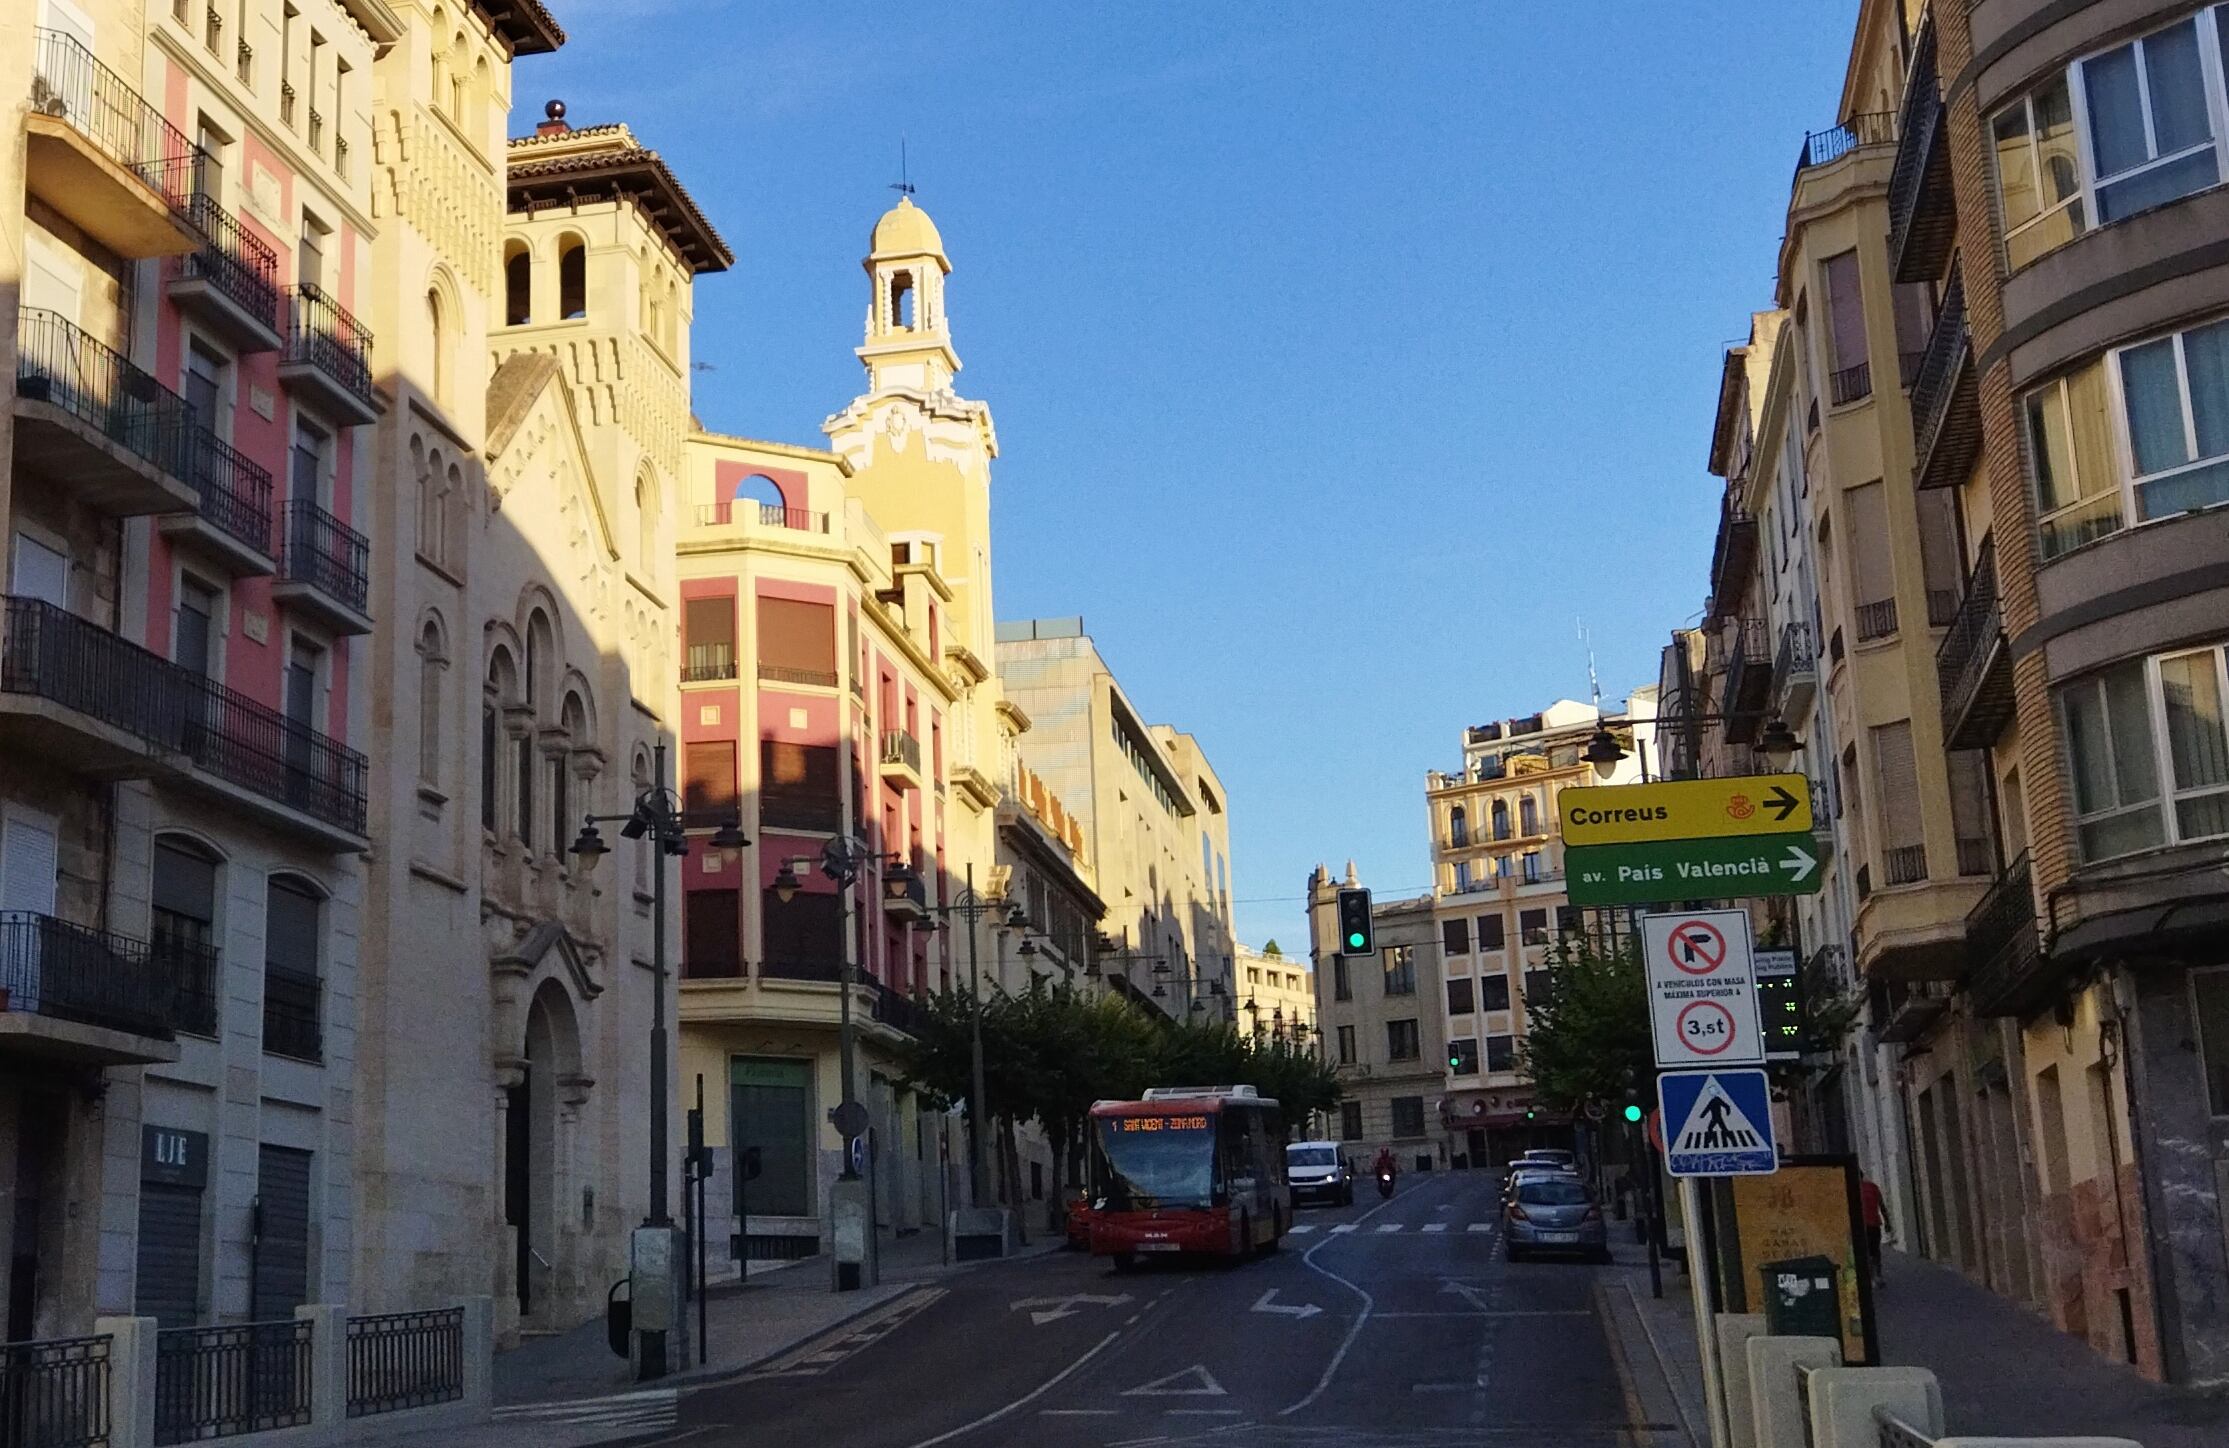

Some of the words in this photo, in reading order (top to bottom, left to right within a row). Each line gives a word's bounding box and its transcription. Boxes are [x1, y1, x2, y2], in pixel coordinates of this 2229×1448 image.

[1570, 806, 1668, 825] Correus
[1582, 871, 1606, 883] av.
[1618, 864, 1663, 882] País
[1676, 857, 1770, 878] Valencià
[1657, 981, 1662, 989] A
[1706, 977, 1722, 987] CON
[1724, 976, 1746, 985] MASA
[1696, 988, 1733, 998] SUPERIOR
